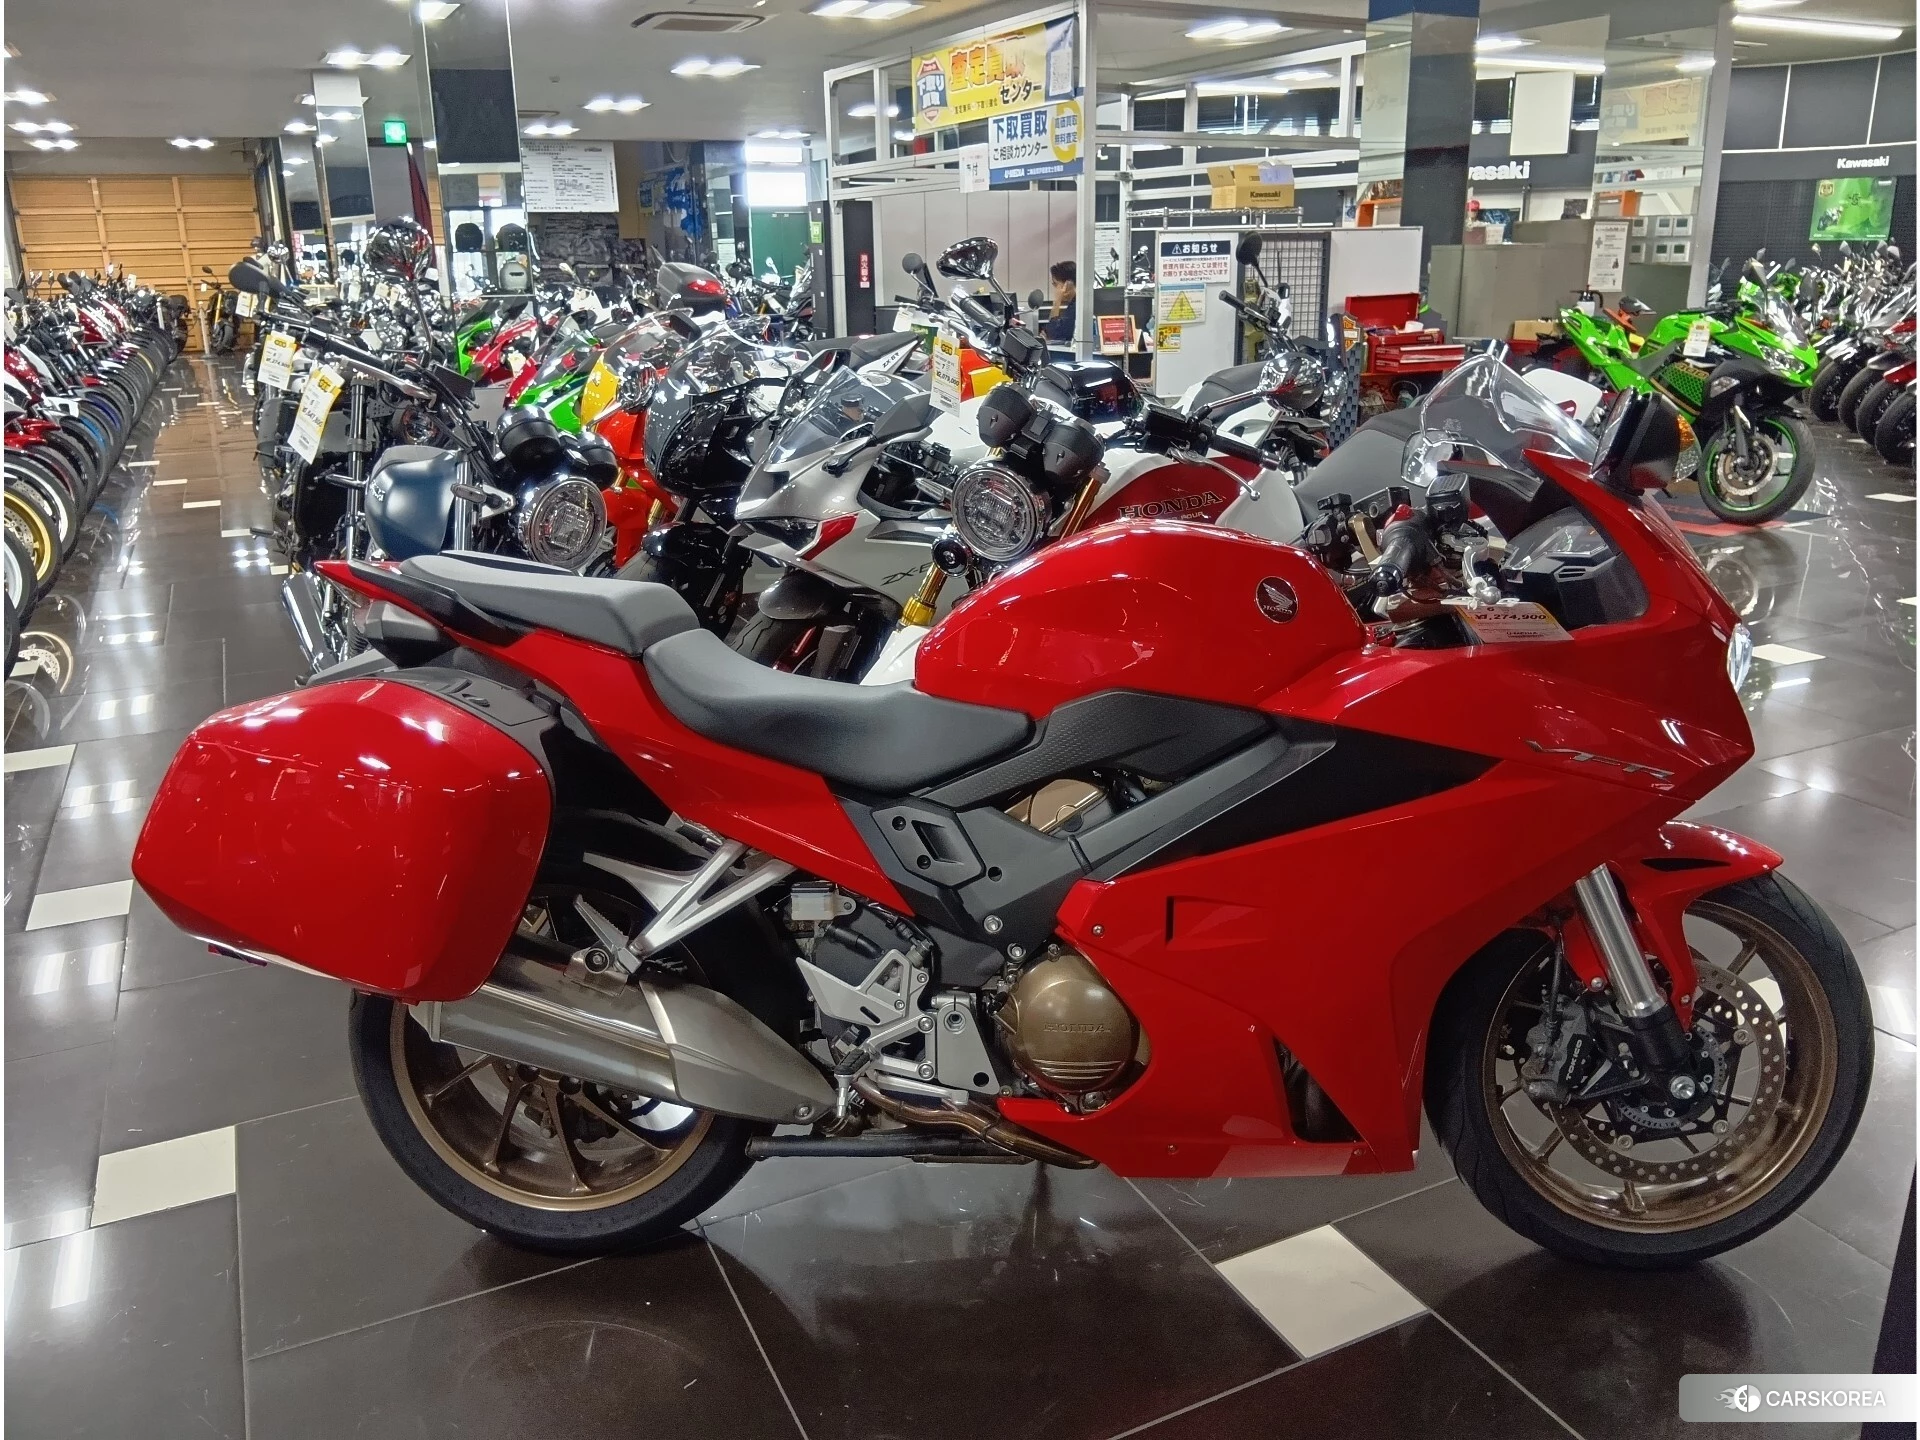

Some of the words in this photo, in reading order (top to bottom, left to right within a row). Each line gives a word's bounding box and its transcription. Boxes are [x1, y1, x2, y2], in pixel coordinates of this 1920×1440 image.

[1000, 79, 1042, 105] センター
[993, 110, 1047, 143] 下取買取
[993, 142, 1048, 161] ご相談カウンター
[1836, 155, 1890, 170] Kawasaki
[1183, 243, 1218, 254] お知らせ
[1118, 490, 1223, 519] HONDA
[1475, 613, 1547, 621] ¥1,274,900
[1042, 1022, 1111, 1034] HONDA
[1565, 1039, 1583, 1081] TOKICO
